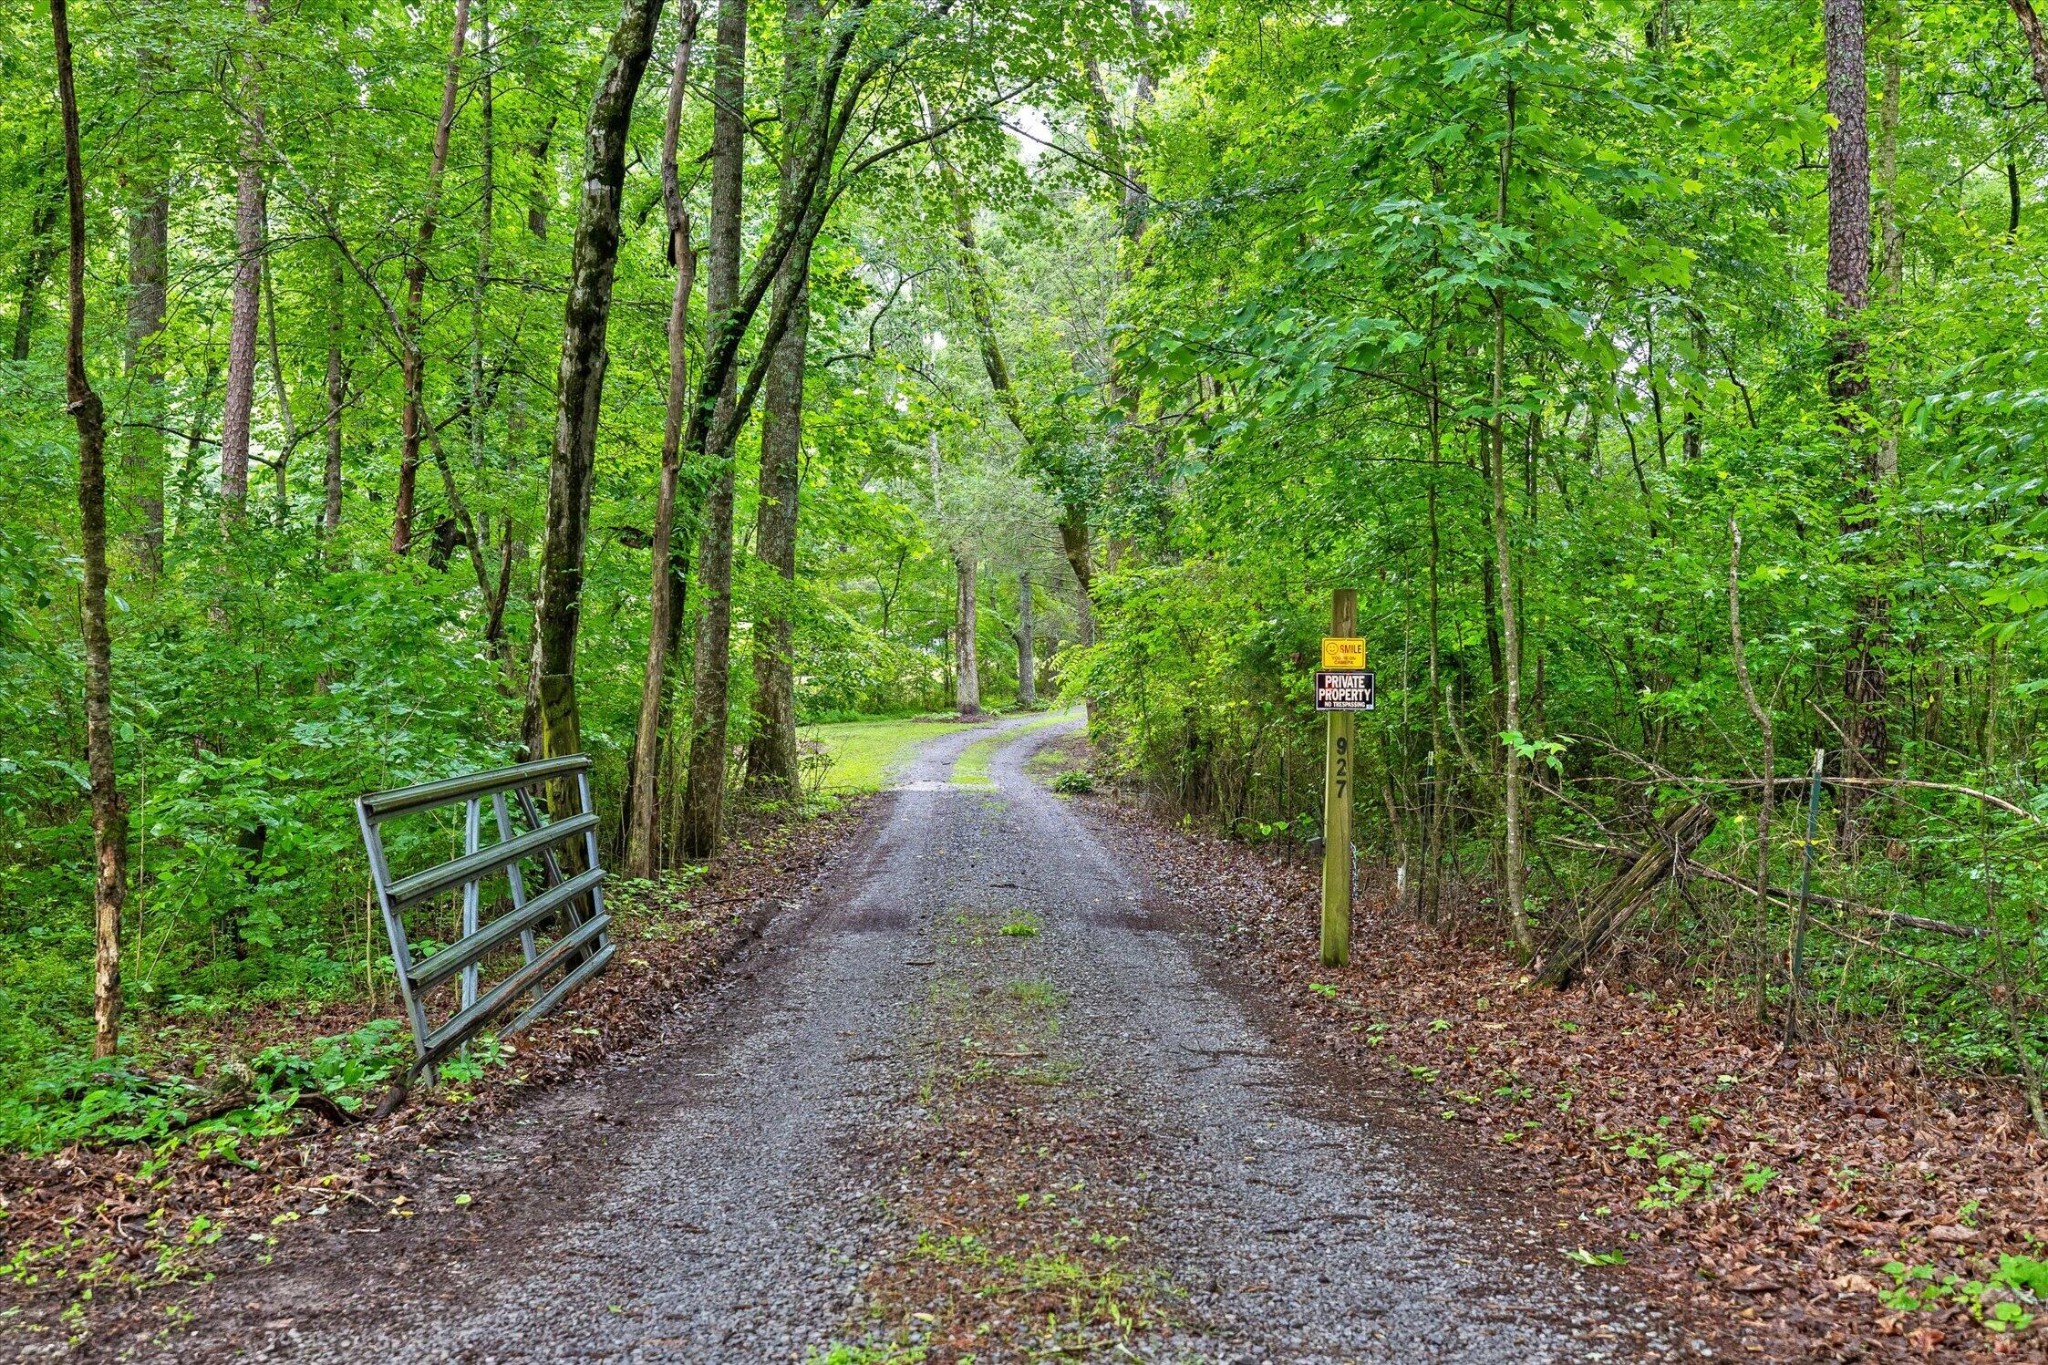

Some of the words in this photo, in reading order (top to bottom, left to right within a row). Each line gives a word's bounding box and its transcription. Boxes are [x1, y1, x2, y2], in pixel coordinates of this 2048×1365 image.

[1340, 645, 1361, 653] SMILE
[1325, 676, 1365, 688] PRIVATE
[1319, 689, 1371, 701] PROPERTY
[1336, 737, 1347, 798] 927
